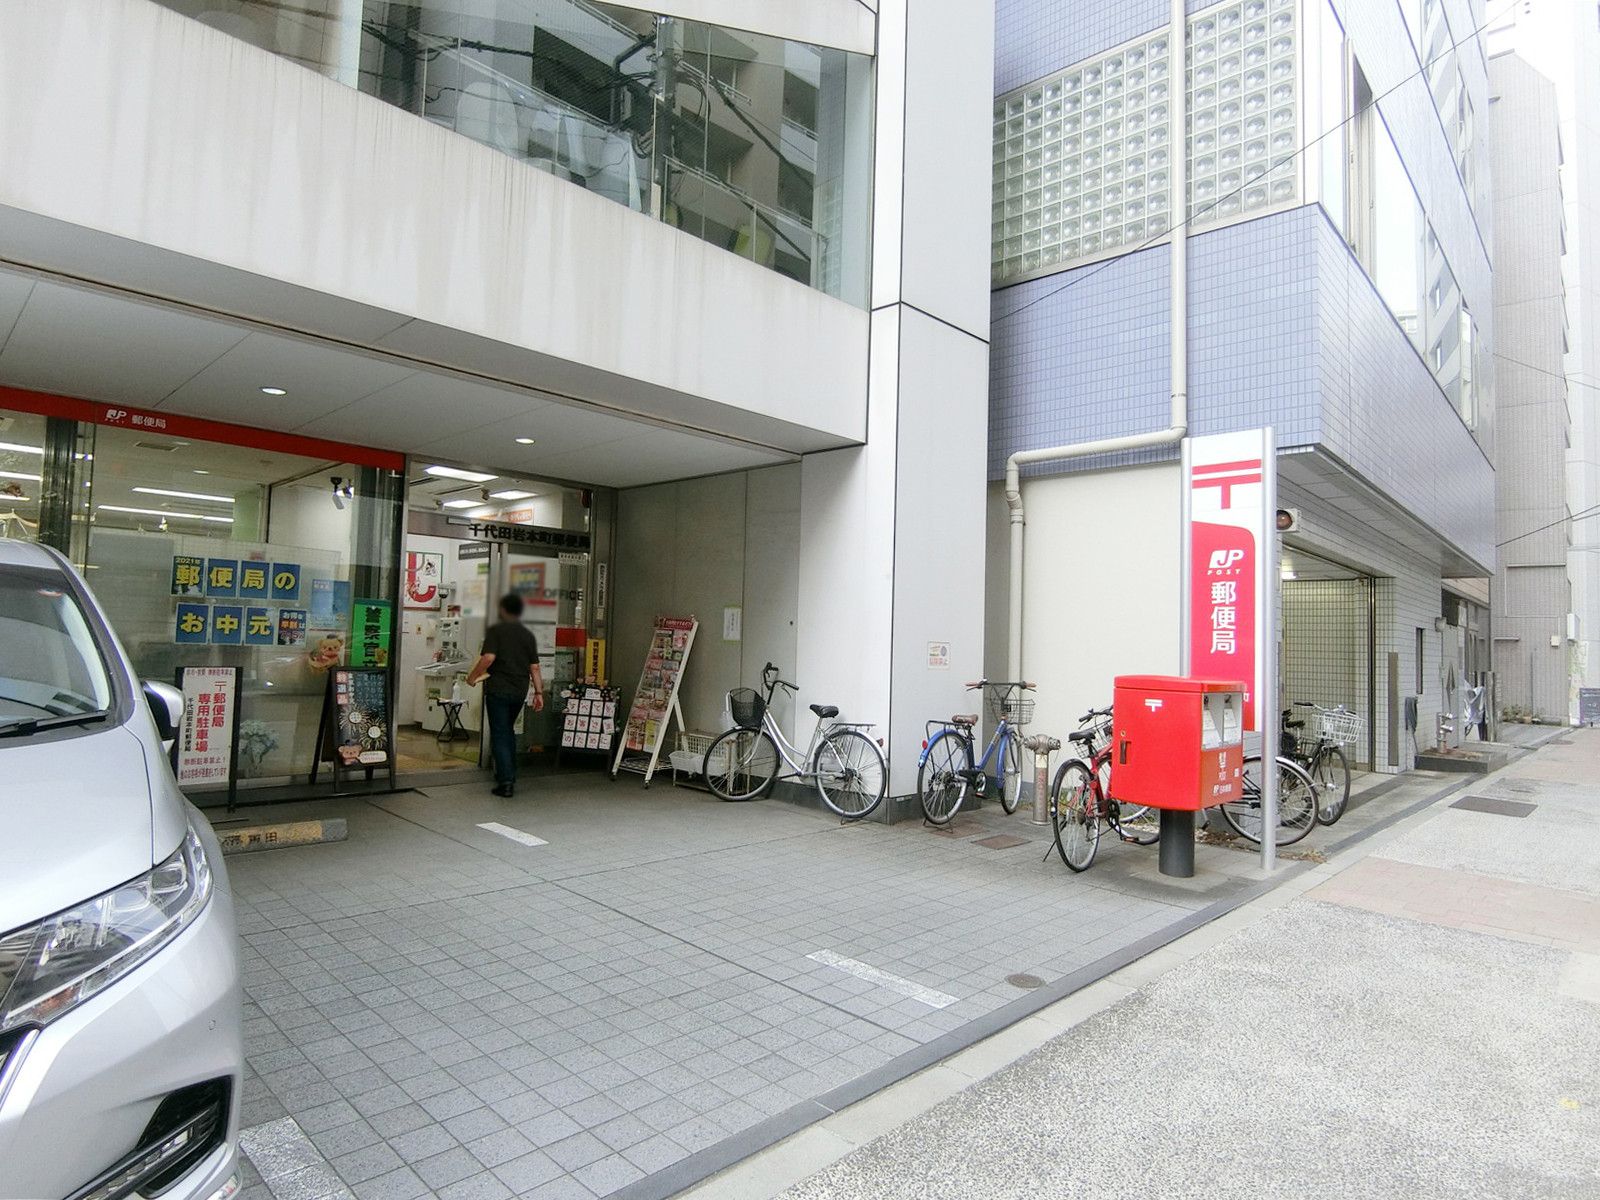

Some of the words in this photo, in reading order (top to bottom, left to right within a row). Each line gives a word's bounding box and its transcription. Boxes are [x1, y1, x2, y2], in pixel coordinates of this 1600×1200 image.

[131, 414, 166, 429] 郵便局
[469, 523, 591, 548] 千代田岩本町郵便局
[175, 565, 296, 591] 郵便局の
[1206, 568, 1241, 576] POST
[180, 612, 272, 637] お中元
[1210, 580, 1236, 655] 郵便局
[194, 693, 212, 753] 専用駐車場
[211, 693, 227, 728] 郵便局
